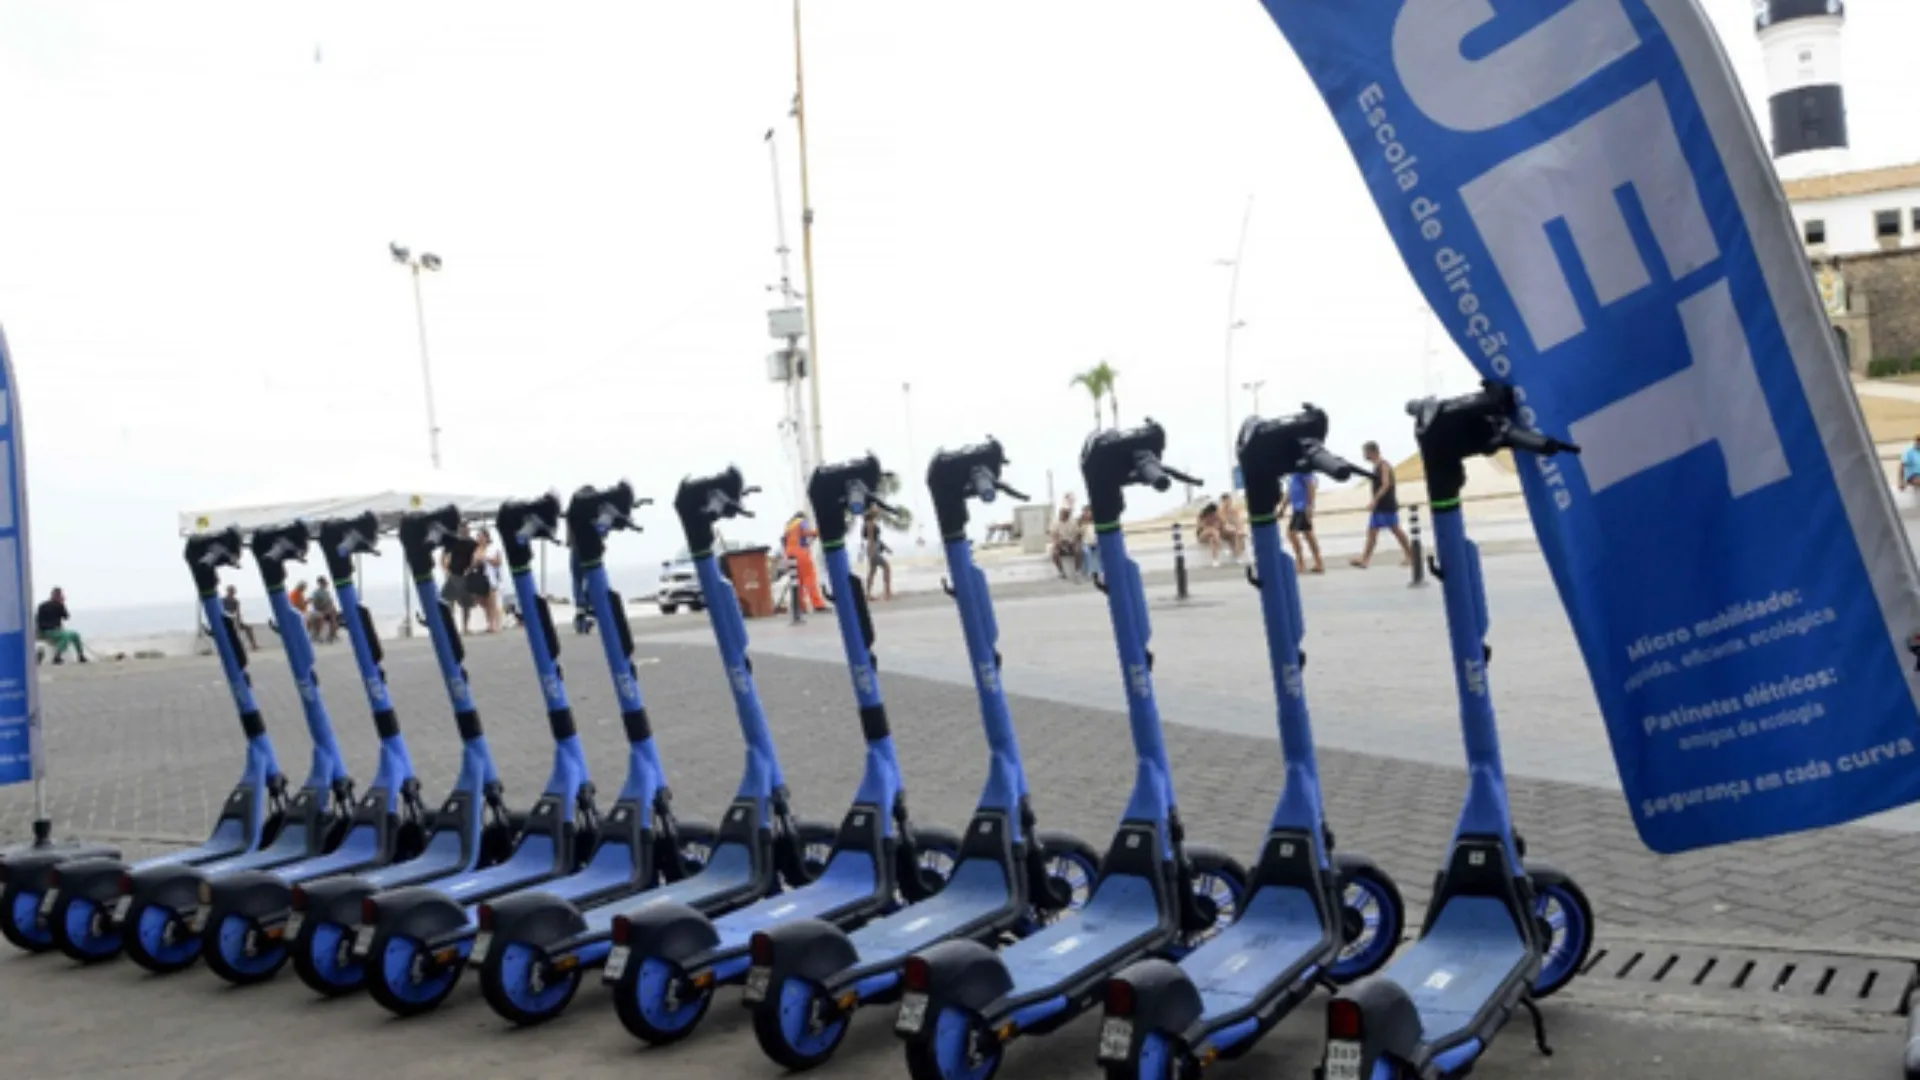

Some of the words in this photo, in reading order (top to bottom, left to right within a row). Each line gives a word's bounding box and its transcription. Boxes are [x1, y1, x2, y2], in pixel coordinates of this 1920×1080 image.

[1357, 81, 1420, 193] Escola
[1409, 196, 1443, 241] de
[1434, 246, 1511, 379] direção
[1391, 0, 1791, 499] JET
[1626, 628, 1690, 661] Micro
[1642, 696, 1742, 737] Patinetes
[1641, 780, 1750, 819] segurança
[1785, 758, 1832, 785] cada
[1836, 736, 1915, 773] curva
